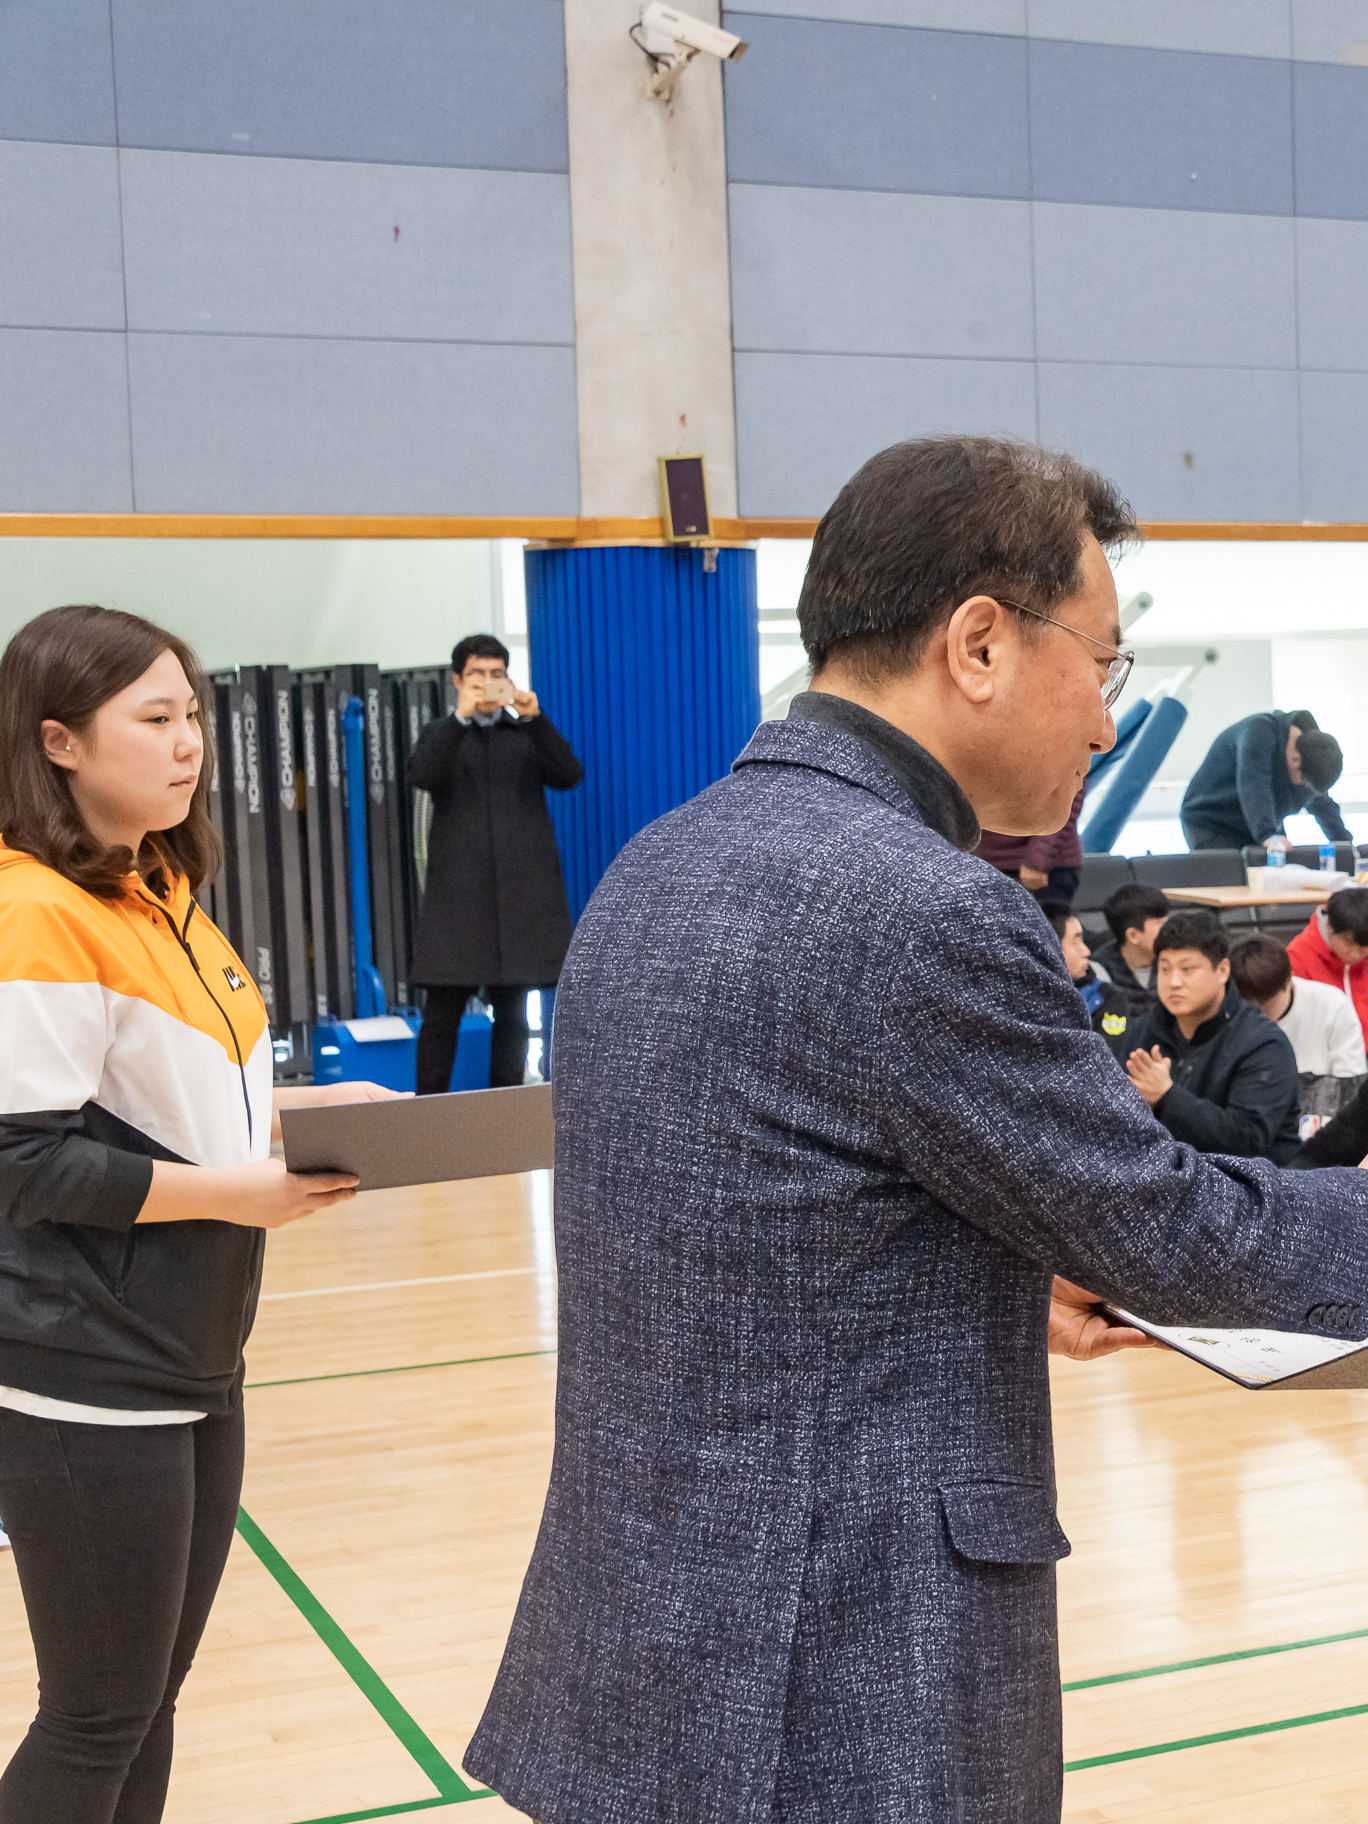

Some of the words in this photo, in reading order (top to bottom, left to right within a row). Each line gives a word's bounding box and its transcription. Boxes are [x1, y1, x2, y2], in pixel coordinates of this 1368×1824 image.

[244, 716, 261, 814] CHAMPION
[278, 690, 294, 787] CHAMPION
[368, 688, 383, 782] CHAMPION
